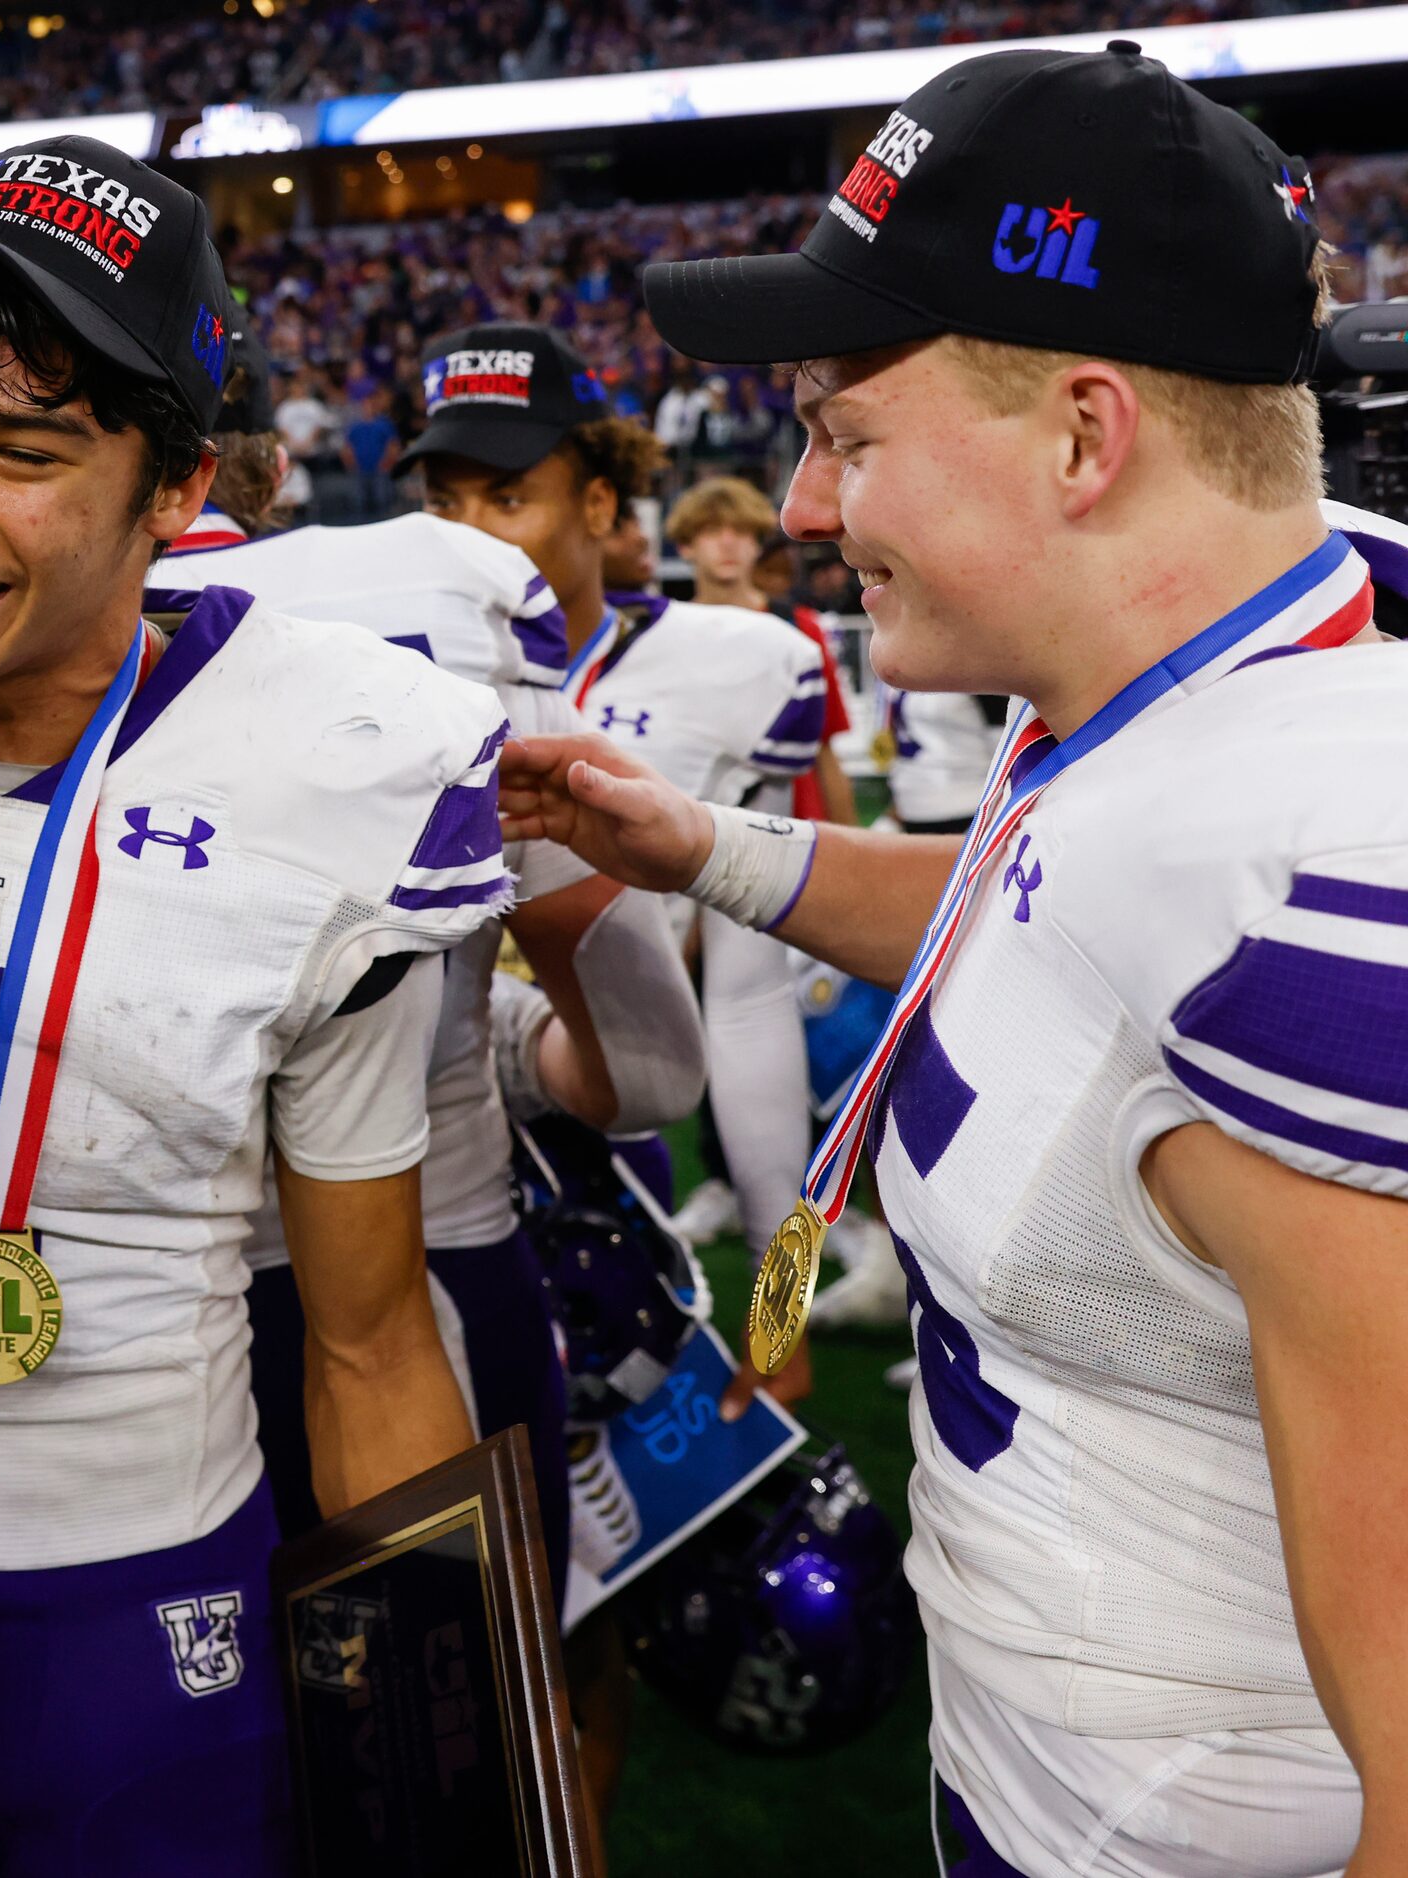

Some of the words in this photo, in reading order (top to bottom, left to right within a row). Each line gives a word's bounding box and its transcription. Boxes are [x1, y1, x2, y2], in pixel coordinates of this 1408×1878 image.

[865, 110, 934, 178] XAS
[30, 219, 125, 284] CHAMPIONSHIPS
[992, 197, 1101, 289] UIL
[445, 350, 535, 378] TEXAS
[22, 1312, 59, 1371] LEAGUE
